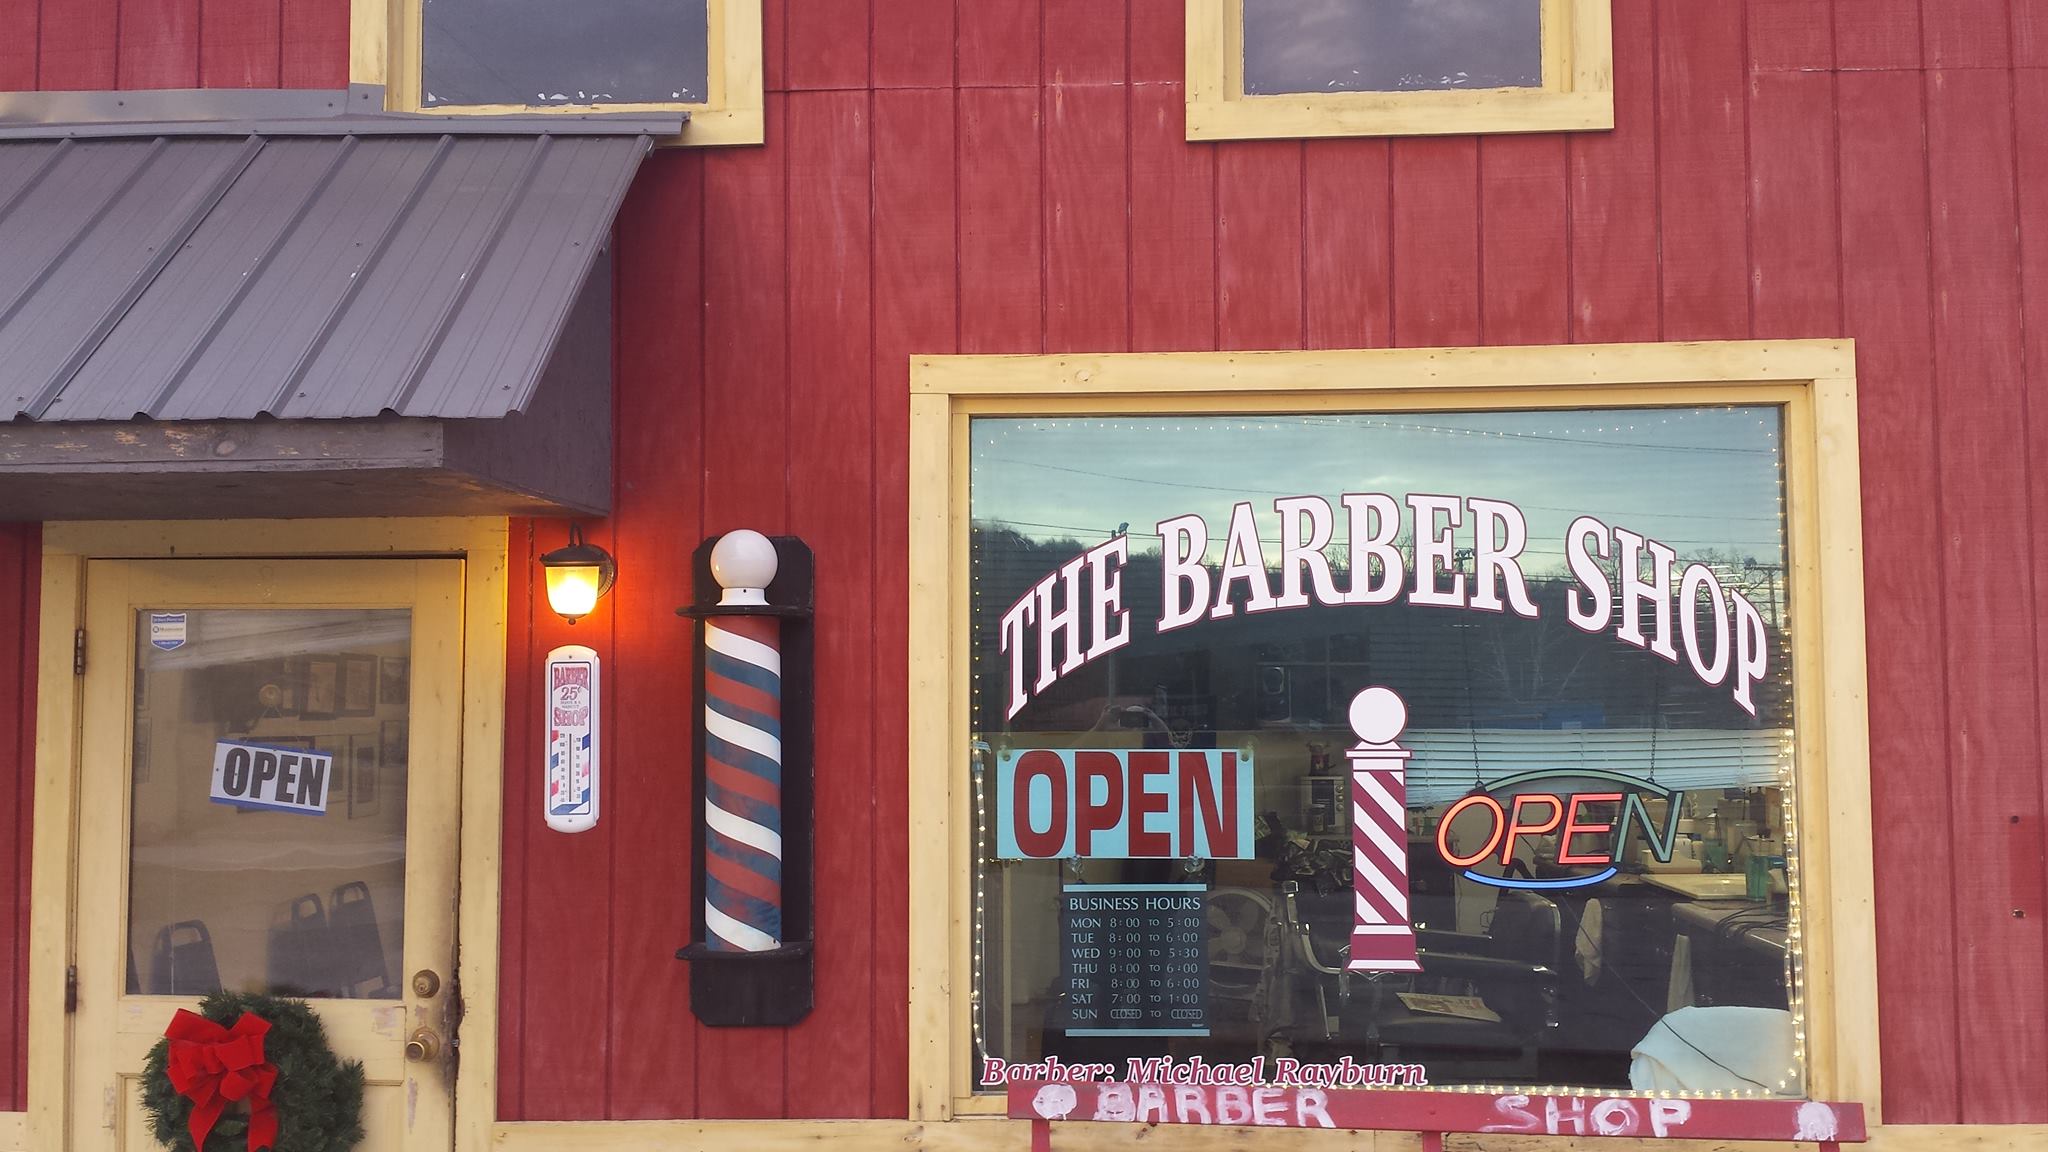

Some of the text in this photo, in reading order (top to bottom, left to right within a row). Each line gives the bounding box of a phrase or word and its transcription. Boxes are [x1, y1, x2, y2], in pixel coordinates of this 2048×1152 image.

[1000, 492, 1768, 722] THE BARBER SHOP
[553, 705, 589, 727] SHOP
[223, 747, 325, 807] OPEN
[1013, 750, 1238, 858] OPEN
[1436, 790, 1684, 868] OPEN
[1069, 897, 1201, 911] BUSINESS HOURS
[1070, 917, 1102, 929] MON
[1148, 918, 1161, 927] TO
[1071, 932, 1095, 944] TUE
[1148, 933, 1161, 942] TO
[1071, 947, 1101, 959] WED
[1148, 948, 1161, 957] TO
[1071, 963, 1098, 974] THU
[1148, 964, 1161, 973] TO
[1071, 978, 1091, 989] FRI
[1149, 979, 1161, 988] TO
[1071, 993, 1094, 1005] SAT
[1149, 994, 1162, 1003] TO
[1071, 1008, 1098, 1020] SUN
[1149, 1009, 1162, 1018] TO
[980, 1055, 1428, 1088] Barber: Michael Rayburn
[1093, 1083, 1692, 1138] BARBER SHOP
